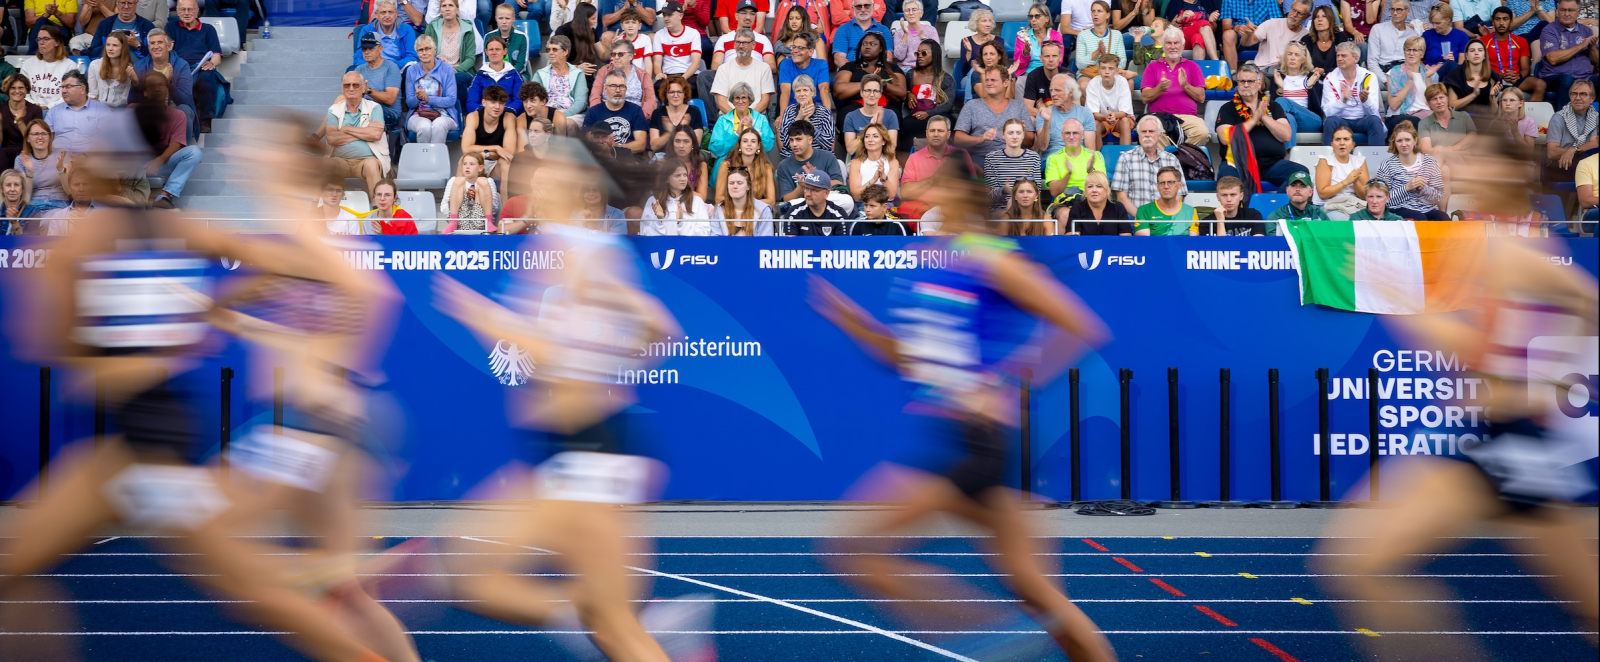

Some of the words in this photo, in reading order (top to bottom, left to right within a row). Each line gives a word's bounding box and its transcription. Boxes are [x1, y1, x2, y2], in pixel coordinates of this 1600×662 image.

[31, 73, 61, 86] CHAMPS
[335, 251, 442, 270] HINE-RUHR
[444, 250, 490, 270] 2025
[492, 251, 519, 270] FISU
[522, 251, 565, 270] GAMES
[680, 255, 718, 266] FISU
[759, 250, 870, 269] RHINE-RUHR
[873, 250, 917, 269] 2025
[921, 250, 947, 269] FISU
[1107, 255, 1145, 266] FISU
[1539, 256, 1573, 266] ISU
[615, 365, 679, 385] Innern
